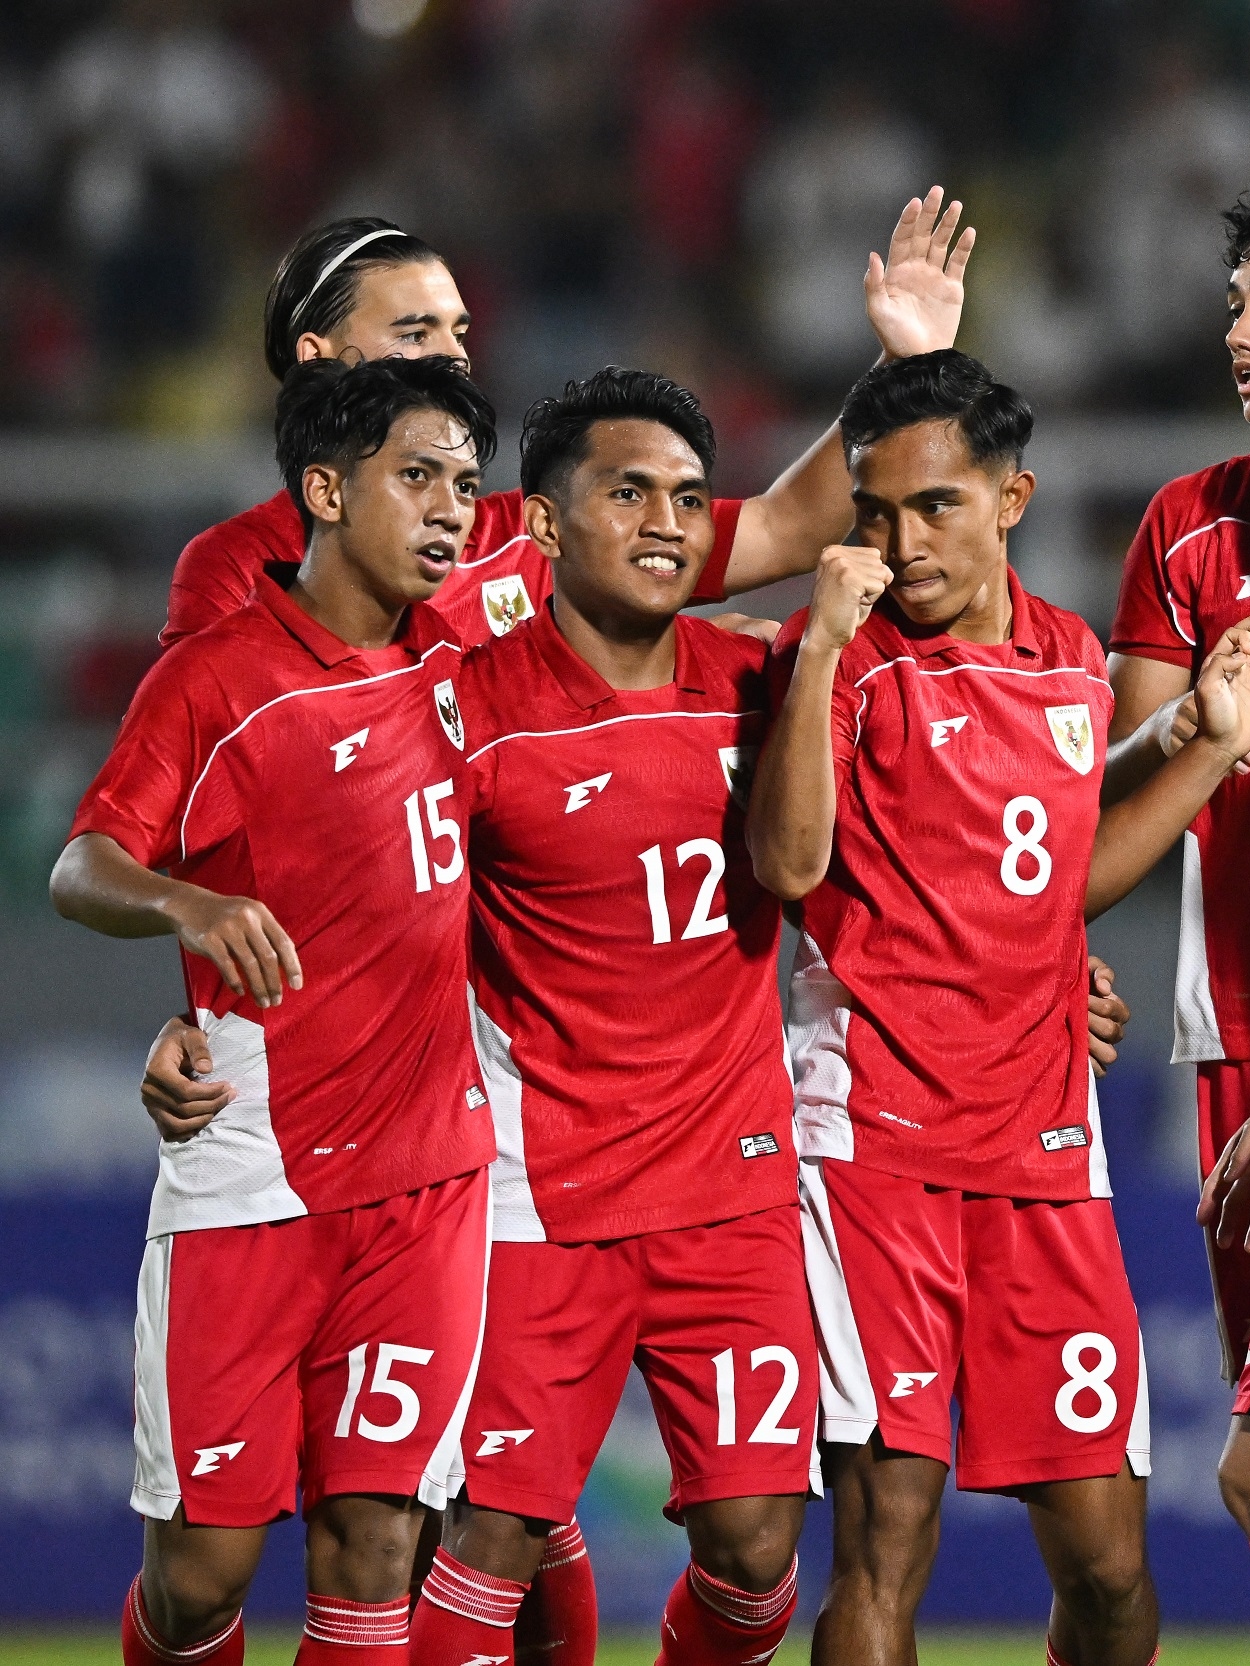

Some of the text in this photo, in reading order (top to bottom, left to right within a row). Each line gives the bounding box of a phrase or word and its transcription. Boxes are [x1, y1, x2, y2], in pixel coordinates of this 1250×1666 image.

[403, 777, 465, 894] 15
[1000, 794, 1053, 896] 8
[637, 837, 729, 945] 12
[333, 1342, 435, 1443] 15
[710, 1345, 801, 1446] 12
[1054, 1331, 1118, 1434] 8
